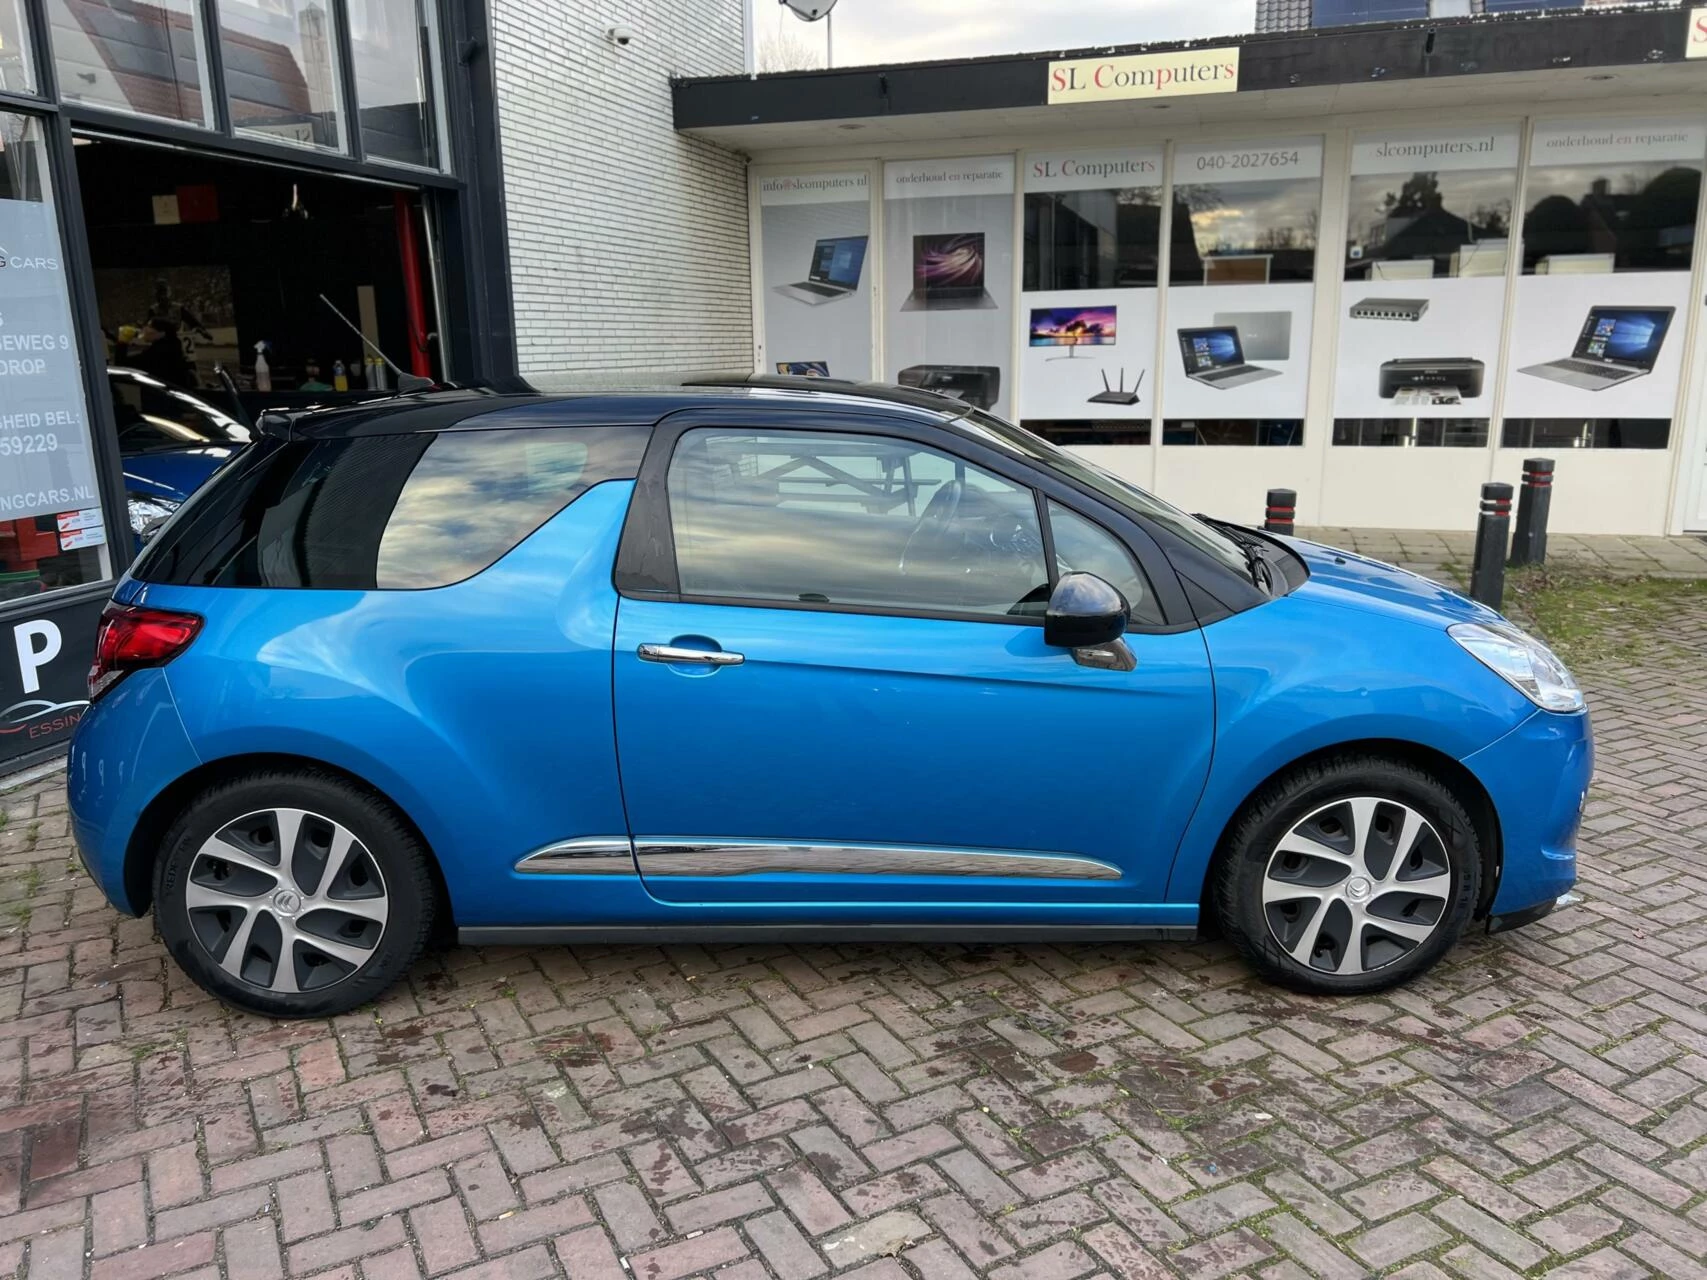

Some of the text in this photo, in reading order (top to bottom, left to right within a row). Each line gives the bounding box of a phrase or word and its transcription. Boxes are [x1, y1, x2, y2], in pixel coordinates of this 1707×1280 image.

[1052, 63, 1234, 92] SL Computers
[1376, 136, 1494, 158] slcomputers.nl
[1546, 131, 1688, 148] onderhoud en reparatie
[1033, 159, 1155, 178] SL Computers
[1197, 151, 1298, 170] 040-2027654
[896, 170, 1003, 184] onderhoud en reparatie
[10, 256, 58, 270] CARS
[0, 334, 69, 351] EWEG 9
[0, 411, 80, 429] HEID BEL:
[13, 619, 62, 694] P
[28, 712, 81, 739] ESSIN
